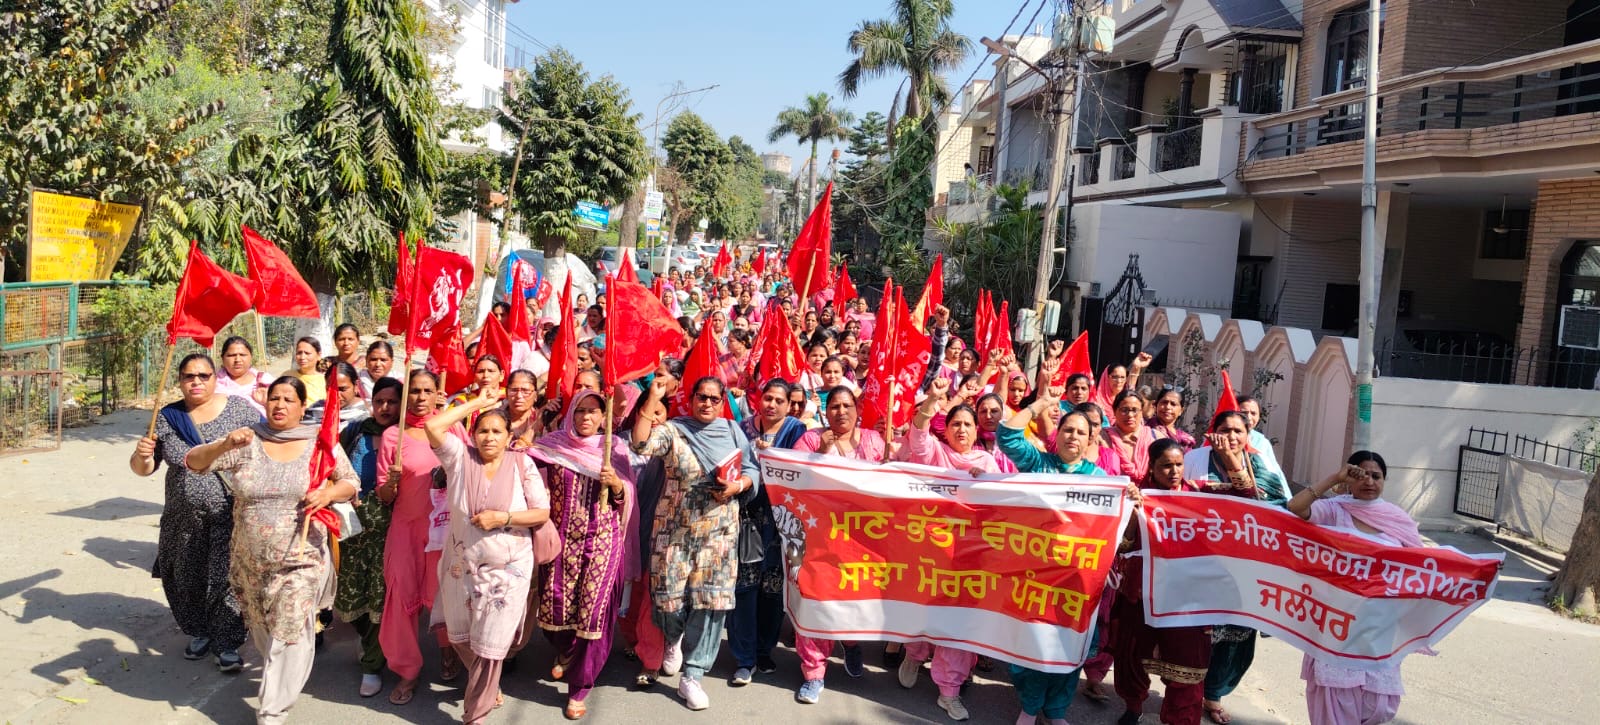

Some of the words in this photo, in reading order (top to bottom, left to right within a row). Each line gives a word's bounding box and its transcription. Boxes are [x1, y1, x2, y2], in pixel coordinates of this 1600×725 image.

[765, 462, 802, 482] ਏਕਤਾ
[1065, 487, 1115, 507] ਸੰਘਰਸ਼
[830, 505, 972, 548] ਮਾਣ-ਭੱਤਾ
[981, 521, 1108, 570] ਵਰਕਰਜ਼
[1150, 506, 1280, 550] ਮਿਡ-ਡੇ-ਮੀਲ
[1285, 532, 1376, 581] ਵਰਕਰਜ਼
[1381, 558, 1486, 601] ਯੂਨੀਅਨ
[838, 554, 908, 592] ਸਾਂਝਾ
[917, 555, 1002, 599] ਮੋਰਚਾ
[1011, 569, 1090, 622] ਪੰਜਾਬ
[1256, 579, 1357, 642] ਜਲੰਧਰ
